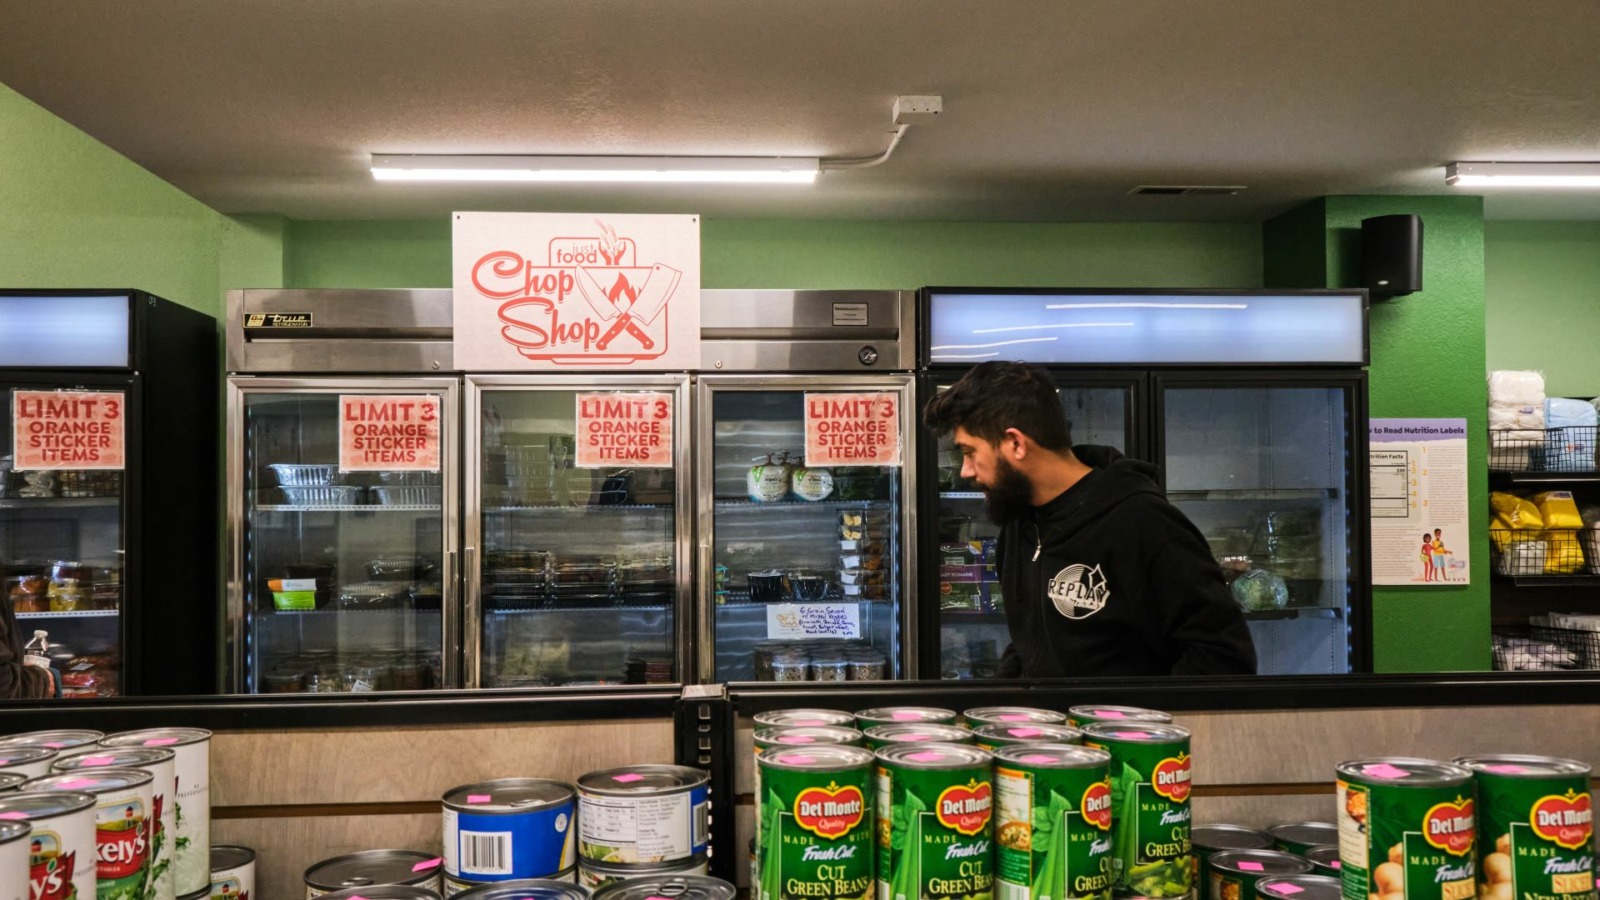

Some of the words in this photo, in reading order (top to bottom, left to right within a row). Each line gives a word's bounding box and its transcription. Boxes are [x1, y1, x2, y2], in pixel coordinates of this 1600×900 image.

[557, 248, 598, 264] food
[572, 242, 595, 255] just
[471, 250, 574, 303] Chop
[267, 314, 307, 322] true
[497, 296, 600, 352] Shop
[20, 399, 97, 419] LIMIT
[104, 400, 120, 419] 3
[345, 403, 415, 421] LIMIT
[420, 403, 435, 421] 3
[581, 401, 648, 419] LIMIT
[654, 401, 668, 419] 3
[810, 401, 875, 419] LIMIT
[880, 400, 894, 418] 3
[29, 421, 111, 434] ORANGE
[353, 424, 427, 436] ORANGE
[589, 421, 660, 433] ORANGE
[817, 420, 887, 433] ORANGE
[29, 435, 110, 448] STICKER
[354, 437, 427, 449] STICKER
[589, 434, 660, 446] STICKER
[818, 433, 886, 446] STICKER
[42, 449, 99, 461] ITEMS
[364, 450, 416, 462] ITEMS
[599, 447, 650, 459] ITEMS
[828, 446, 877, 458] ITEMS
[1048, 579, 1107, 603] REPLAY
[1158, 771, 1175, 785] Del
[800, 801, 821, 816] Del
[823, 800, 861, 816] Monte
[943, 800, 964, 815] Del
[965, 796, 992, 813] Mont
[1087, 797, 1103, 812] Del
[1141, 803, 1170, 811] MADE
[818, 819, 846, 830] Quality
[1538, 810, 1562, 826] Del
[1430, 818, 1453, 834] Del
[783, 835, 815, 845] MADE
[924, 835, 957, 843] MADE
[1071, 832, 1099, 842] MADE
[96, 832, 147, 864] kely's
[802, 845, 835, 862] Fresh
[834, 844, 858, 860] Cut
[944, 843, 974, 861] Fresh
[1145, 842, 1182, 857] GREEN
[1518, 847, 1556, 857] MADE
[1410, 856, 1447, 865] MADE
[1544, 857, 1578, 875] Fresh
[817, 864, 846, 881] CUT
[959, 861, 983, 877] CUT
[1434, 865, 1464, 883] Fresh
[787, 878, 832, 896] GREEN
[834, 876, 868, 895] BEANS
[929, 877, 972, 894] GREEN
